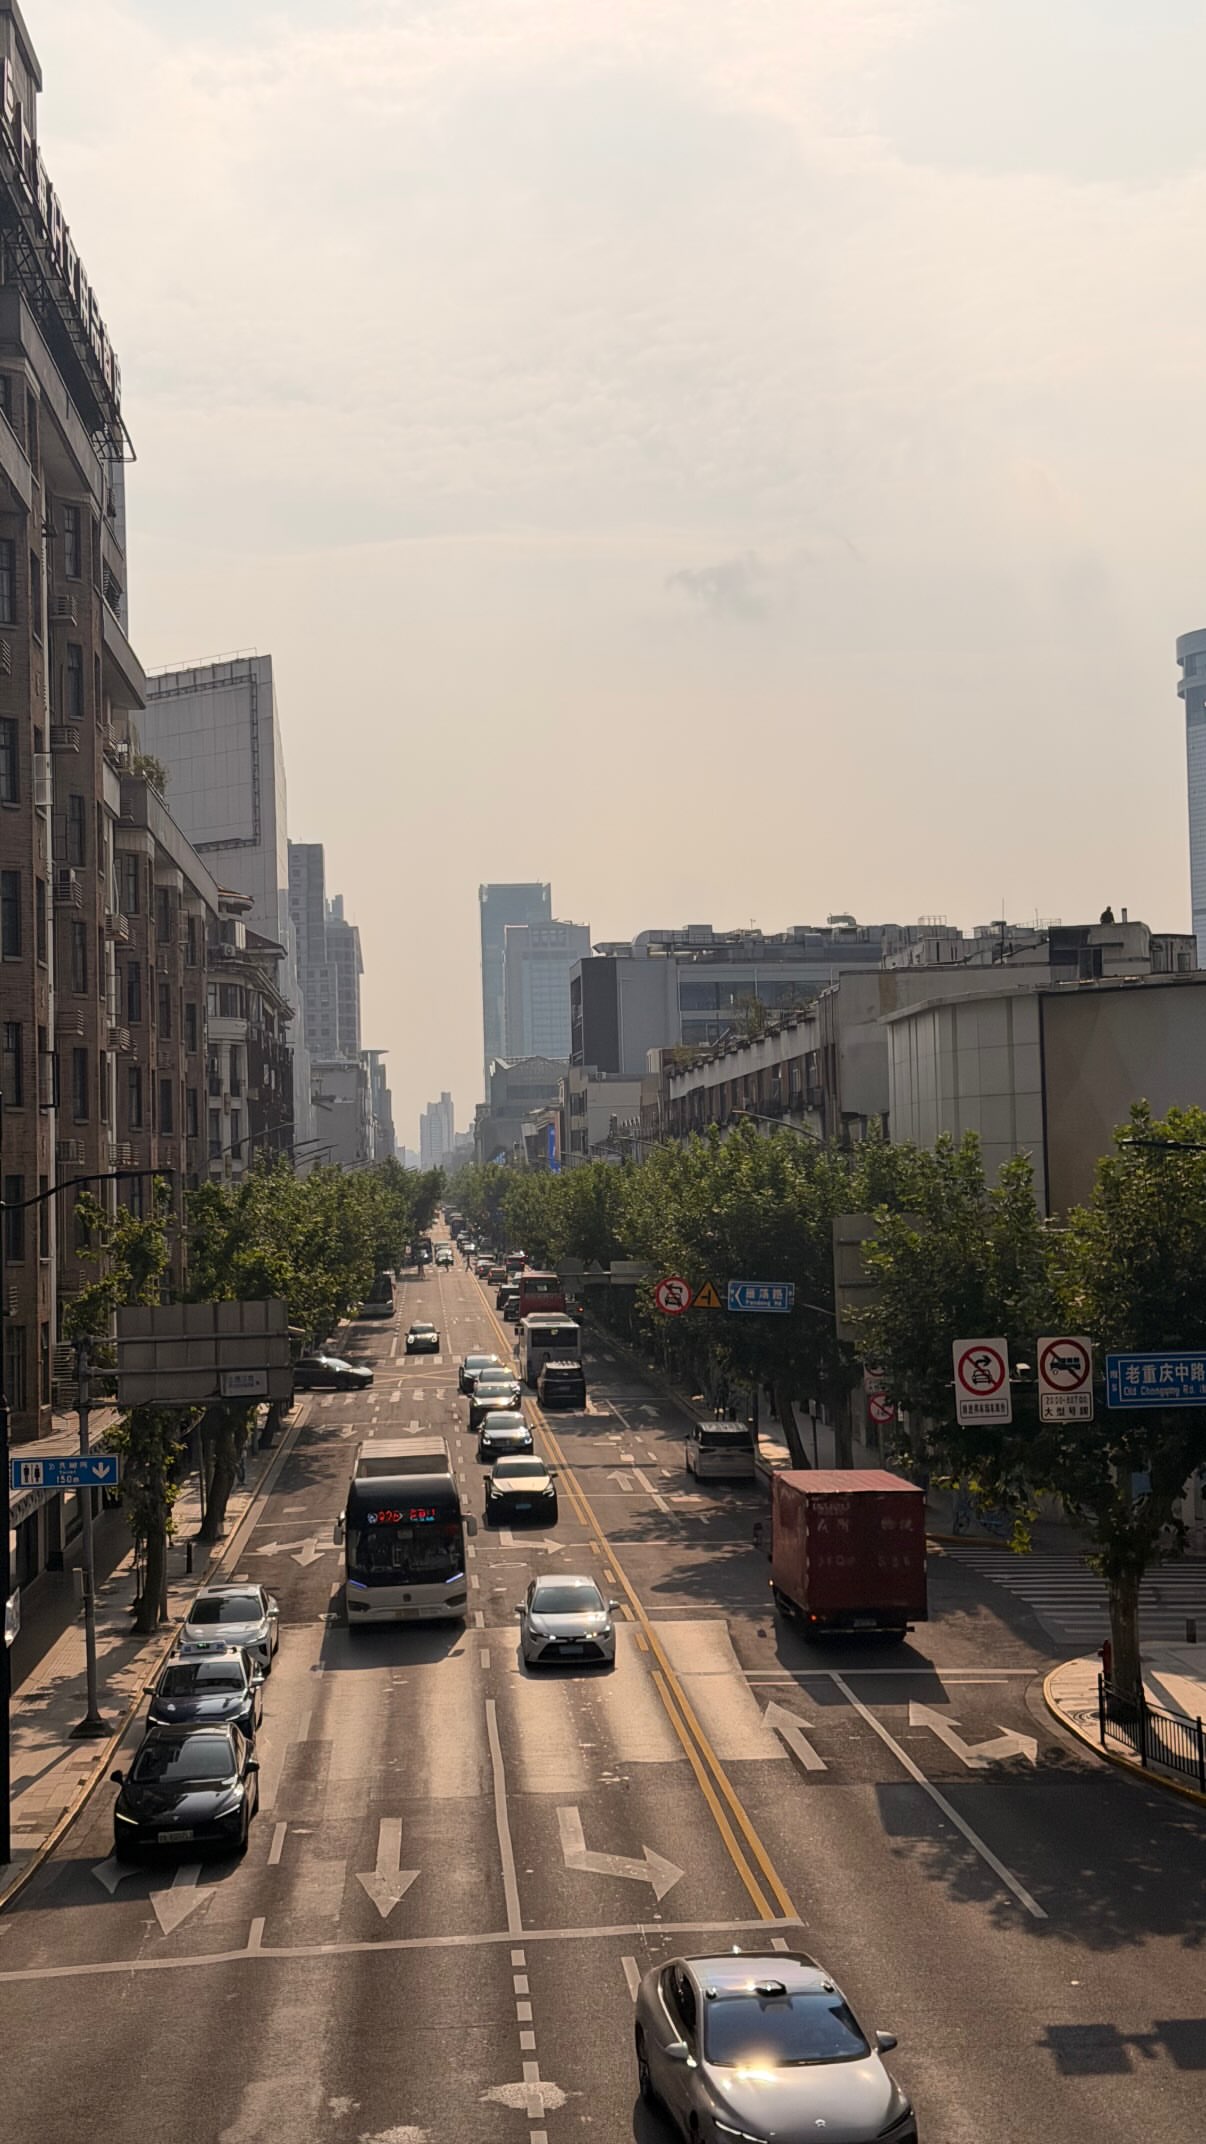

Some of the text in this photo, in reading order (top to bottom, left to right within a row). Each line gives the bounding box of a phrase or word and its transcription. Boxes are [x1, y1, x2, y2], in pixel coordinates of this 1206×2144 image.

[1125, 1362, 1206, 1384] 老重庆中路
